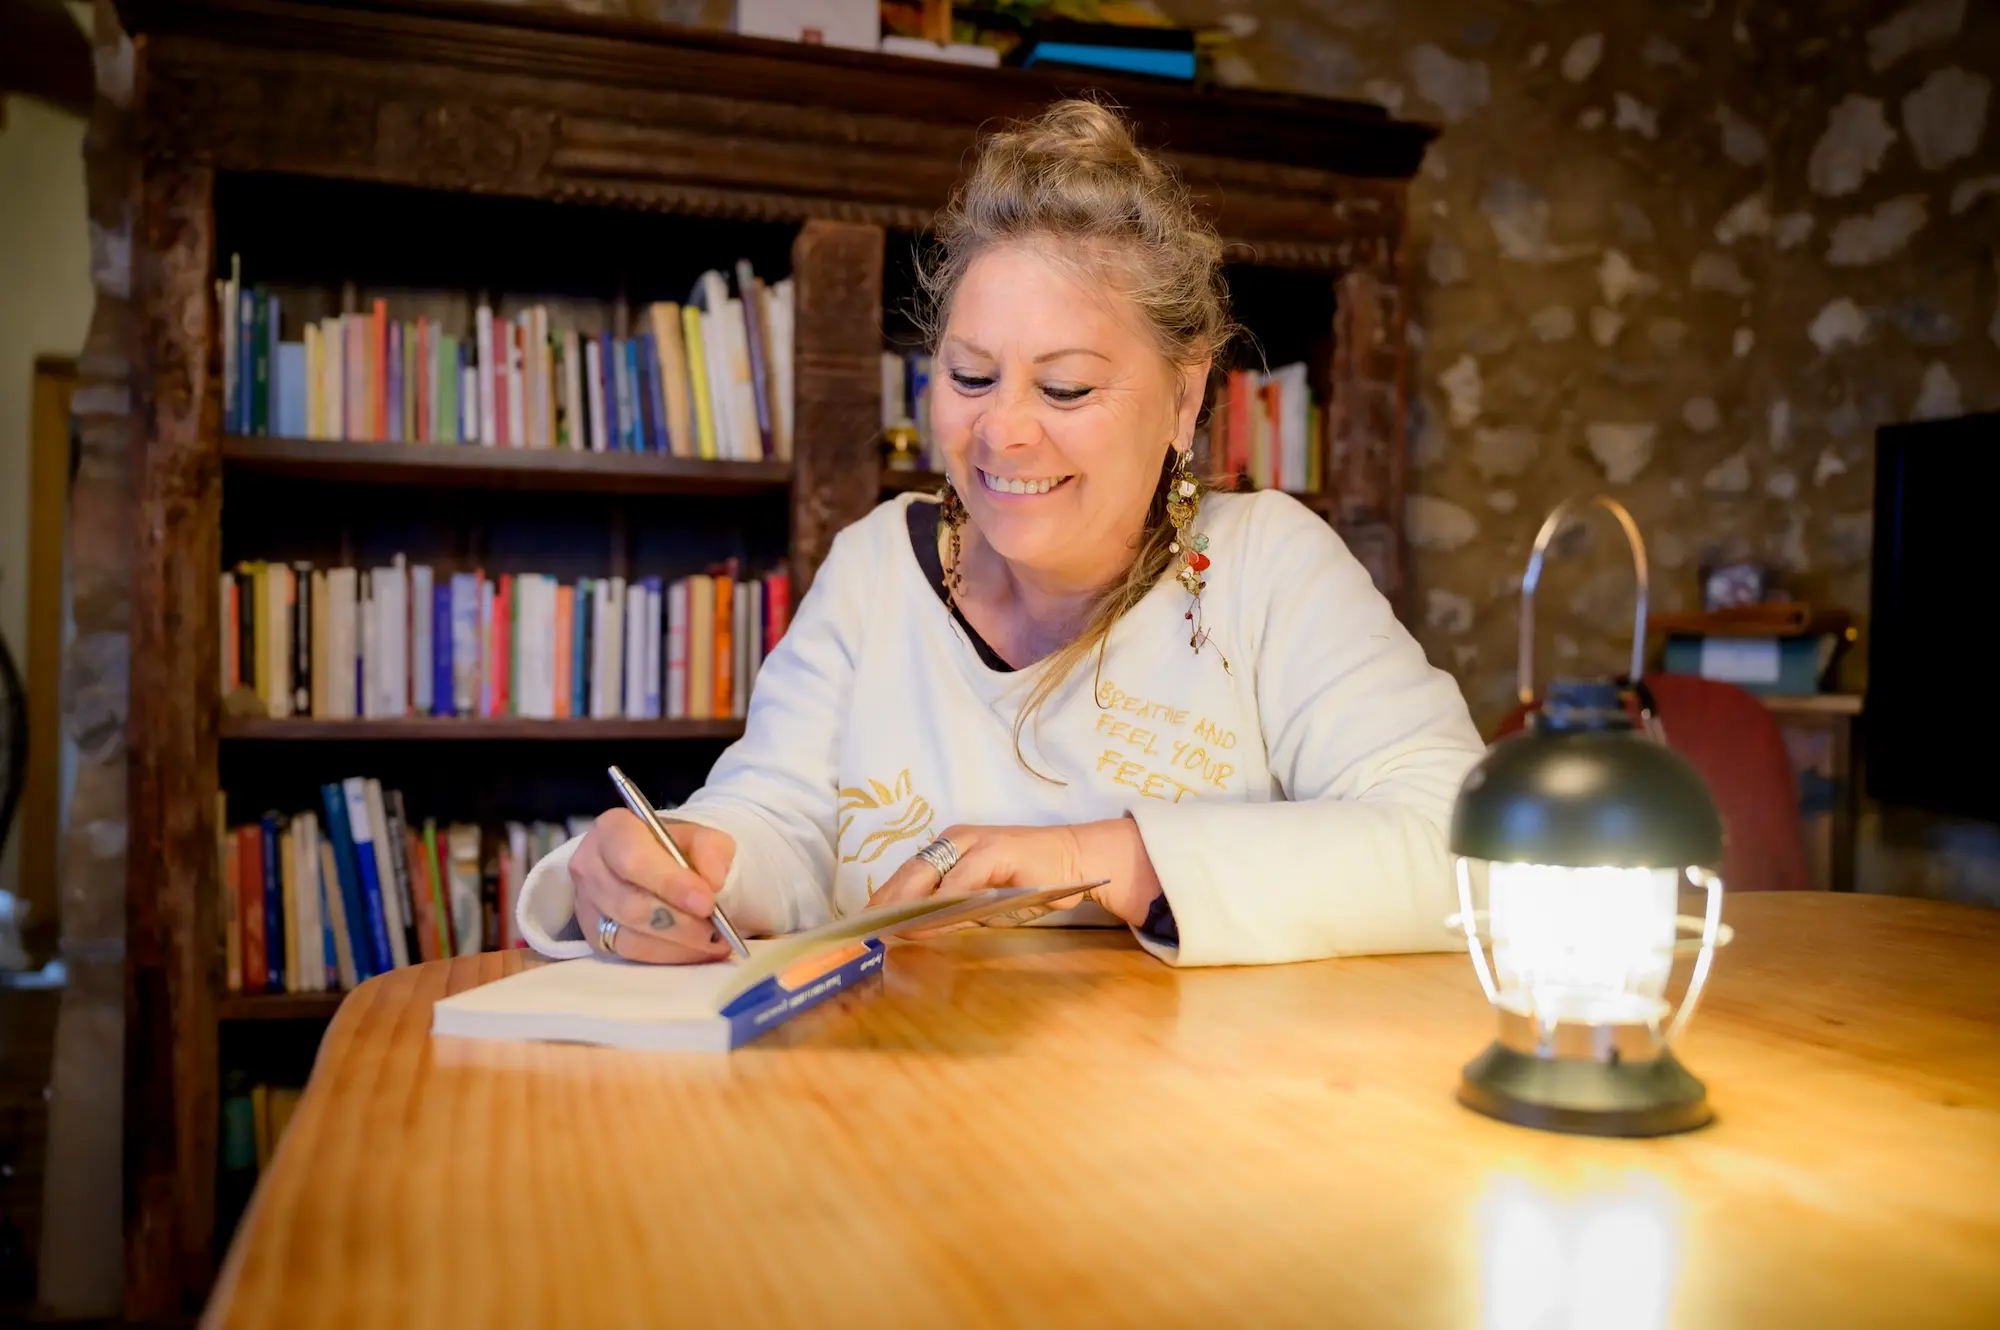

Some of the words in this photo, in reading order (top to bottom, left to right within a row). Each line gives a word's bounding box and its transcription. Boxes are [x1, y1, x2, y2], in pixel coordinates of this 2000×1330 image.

[1098, 680, 1190, 725] BREATHE
[1193, 717, 1237, 749] AND
[1095, 713, 1159, 756] FEEL
[1170, 740, 1235, 790] YOUR
[1096, 748, 1200, 804] FEET
